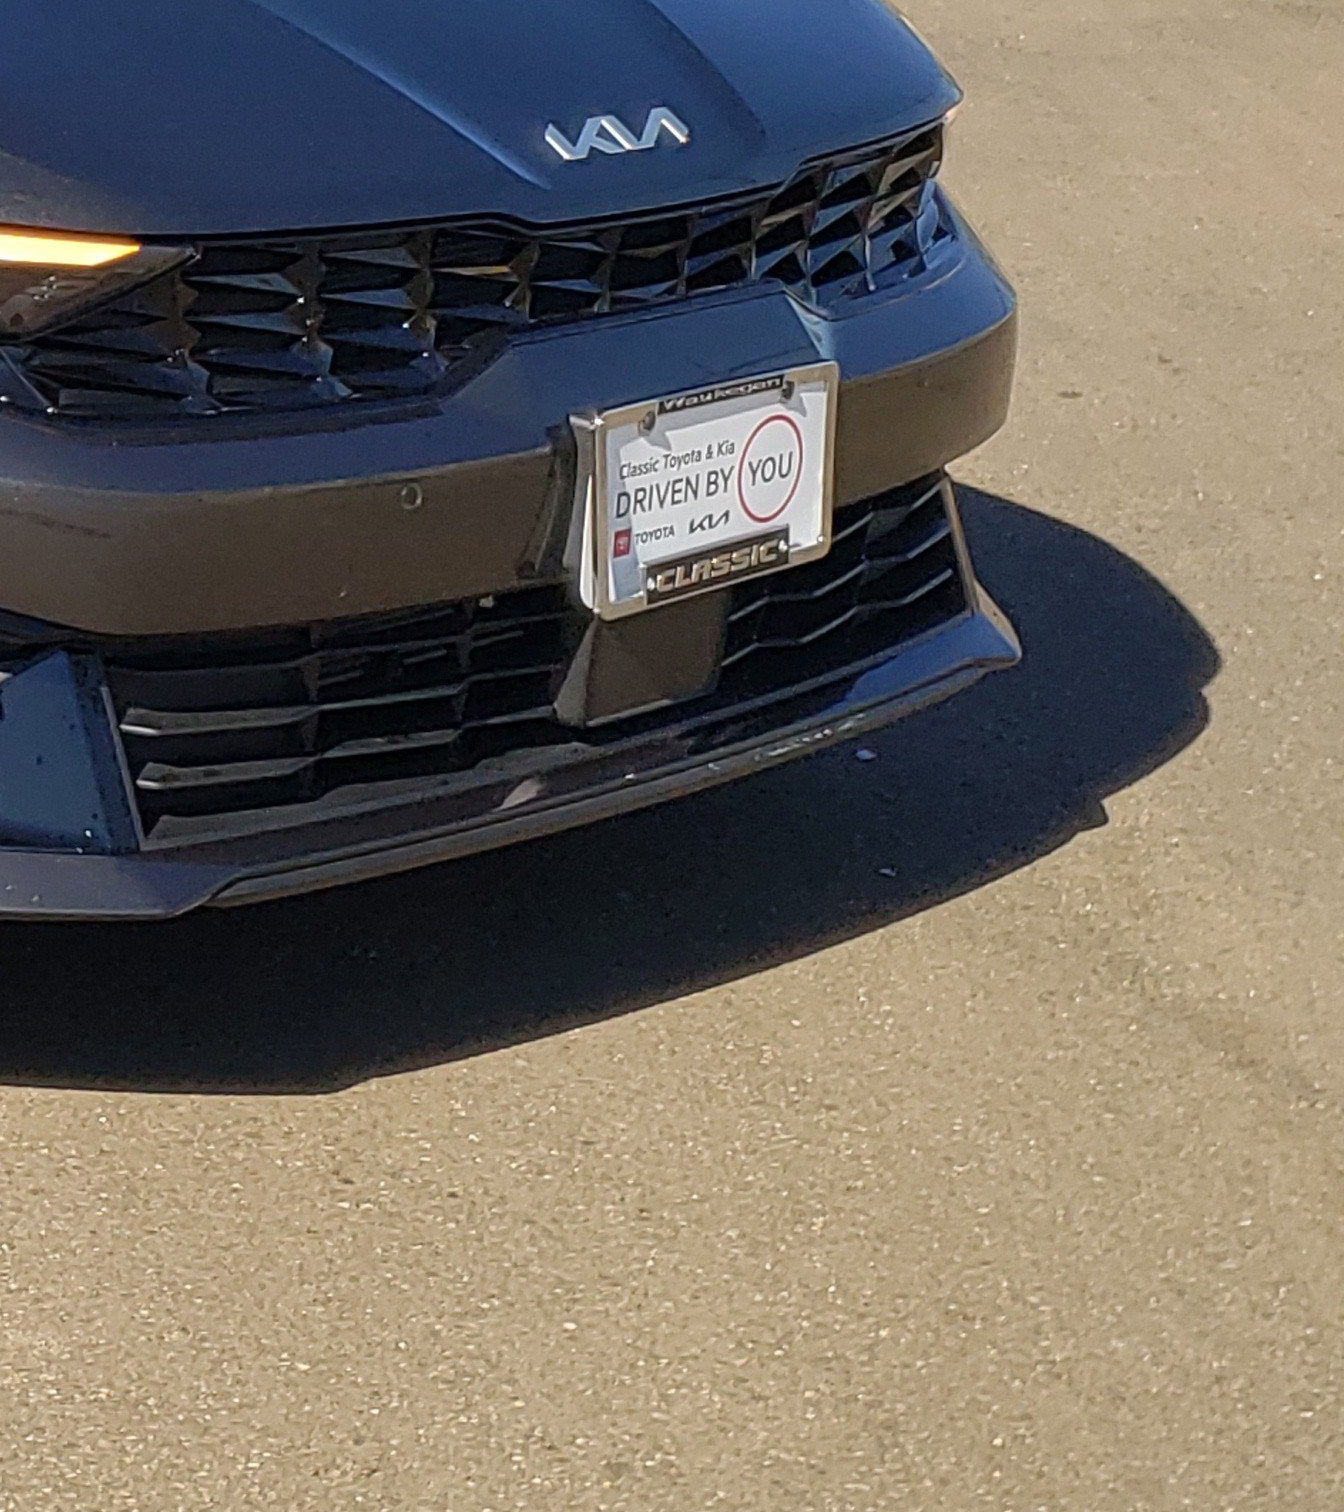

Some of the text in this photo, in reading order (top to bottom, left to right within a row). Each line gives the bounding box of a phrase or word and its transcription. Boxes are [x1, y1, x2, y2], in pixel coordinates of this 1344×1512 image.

[544, 106, 690, 161] KIA
[664, 377, 782, 410] Waukegan
[619, 440, 735, 480] Classic Toyota & Kia
[616, 451, 793, 519] DRIVEN BY YOU
[634, 525, 675, 544] TOYOTA
[656, 539, 779, 593] CLASSIC
